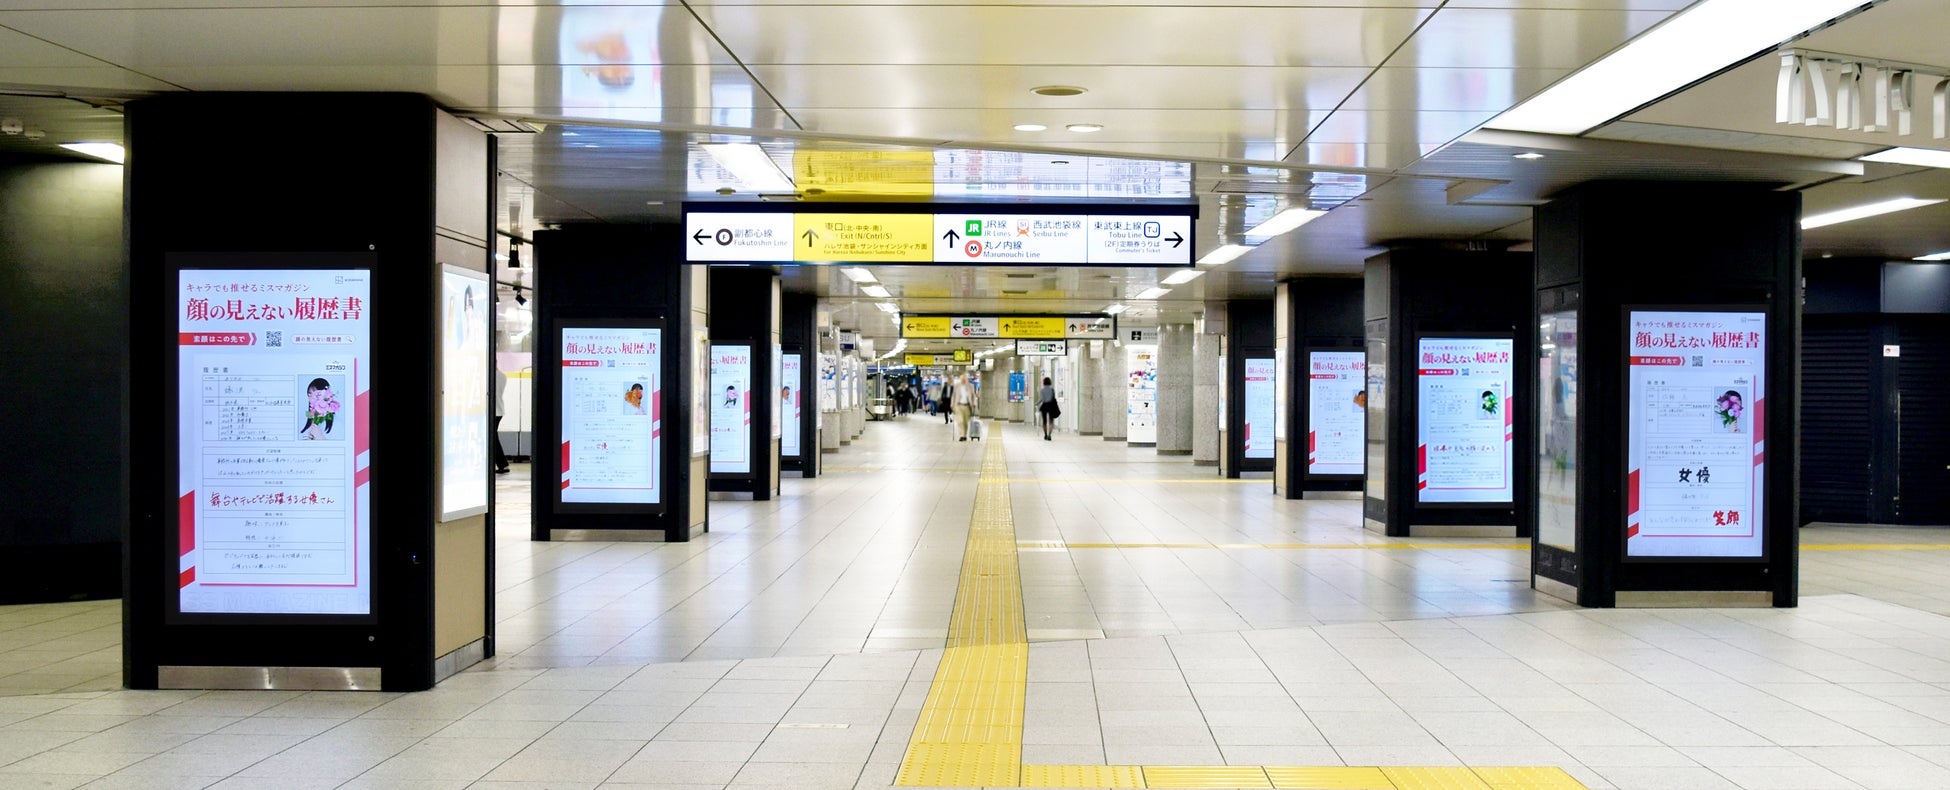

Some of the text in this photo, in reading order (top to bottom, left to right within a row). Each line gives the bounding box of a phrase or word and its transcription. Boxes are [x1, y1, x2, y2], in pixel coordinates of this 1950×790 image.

[968, 224, 979, 232] JR
[984, 220, 1007, 229] JR線
[1033, 220, 1082, 230] 西武池袋線
[1094, 221, 1142, 230] 東武東上線
[734, 229, 773, 238] 副都心線
[984, 241, 1022, 250] 丸ノ内線
[186, 283, 311, 293] キャラでも推せるミスマガジン
[186, 296, 362, 321] 顔の見えない履歴書
[193, 335, 246, 343] 素顔はこの先で
[1635, 331, 1760, 349] 顔の見えない履歴書
[566, 343, 657, 354] 顔の見えない履歴書
[1422, 352, 1509, 364] 顔の見えない履歴書
[1679, 466, 1711, 484] 女優
[210, 491, 335, 508] 舞台やテレビで活躍する女優さん
[1713, 510, 1740, 526] 笑顔
